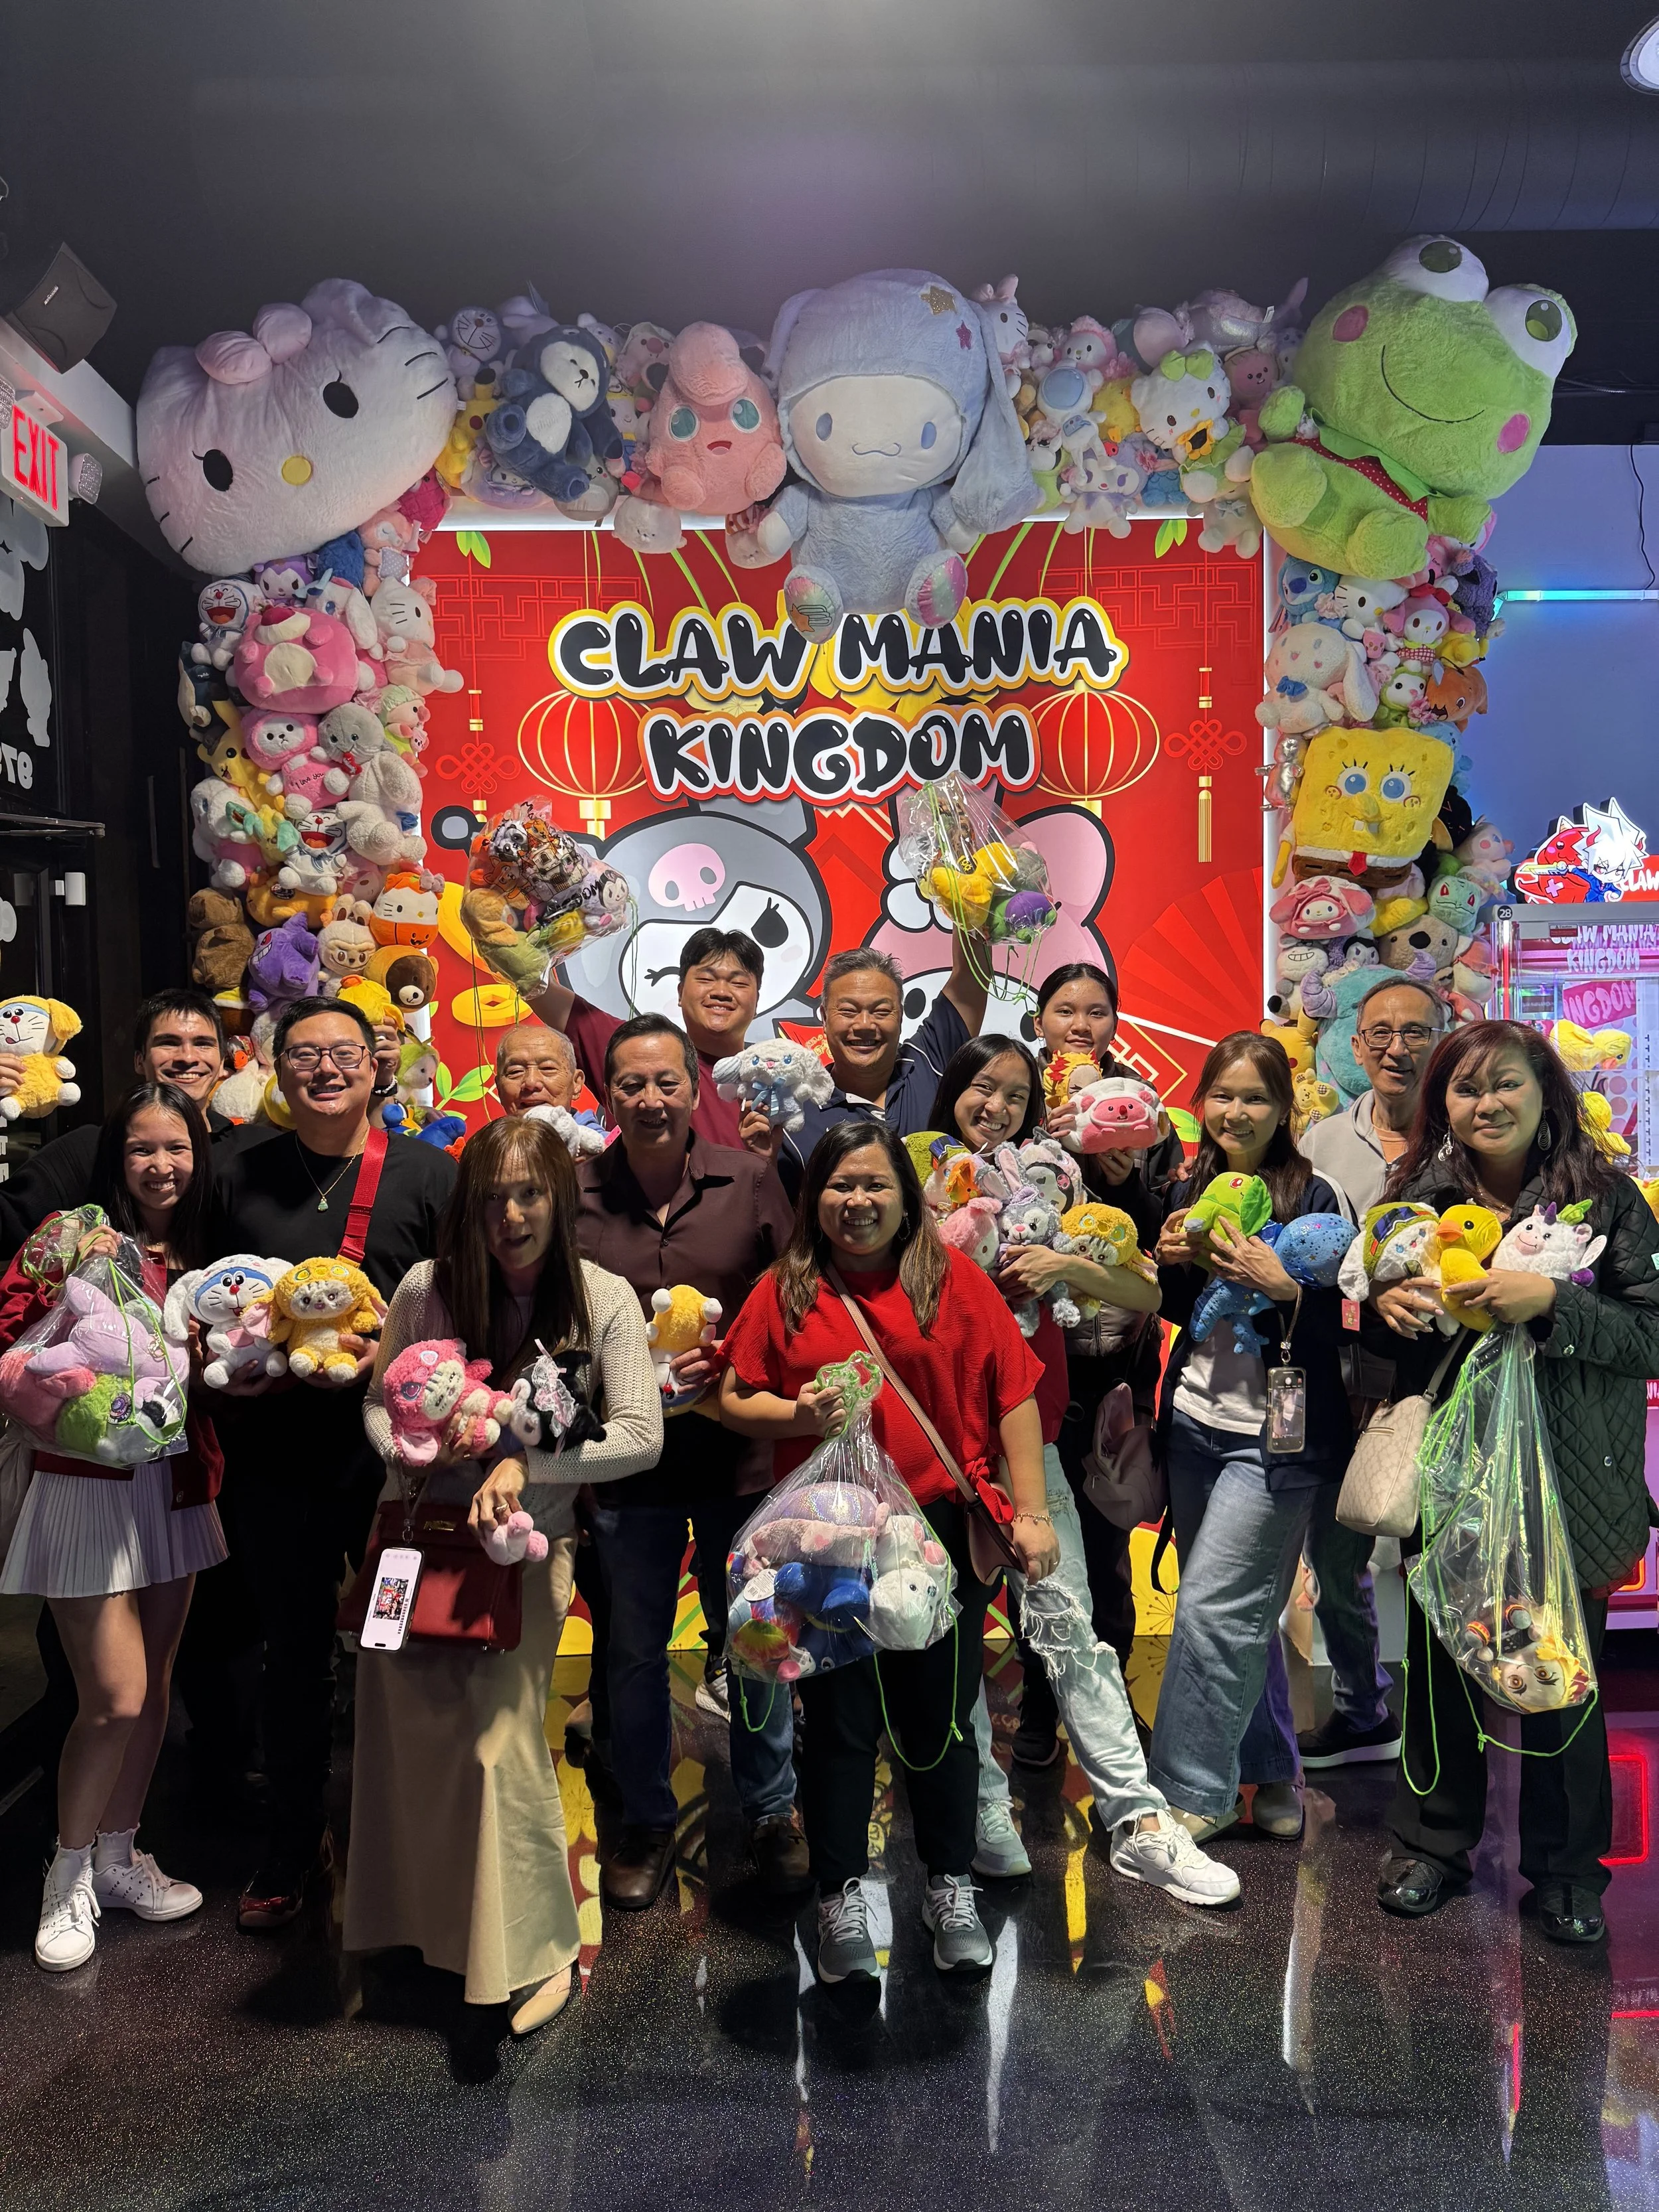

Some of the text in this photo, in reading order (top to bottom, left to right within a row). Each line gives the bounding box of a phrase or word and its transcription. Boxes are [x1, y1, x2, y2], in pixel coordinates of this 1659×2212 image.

[13, 404, 59, 511] EXIT
[560, 607, 1118, 689] CLAW MANIA
[648, 715, 1035, 795] KINGDOM
[1500, 909, 1512, 919] 28
[1567, 947, 1640, 974] KINGDOM
